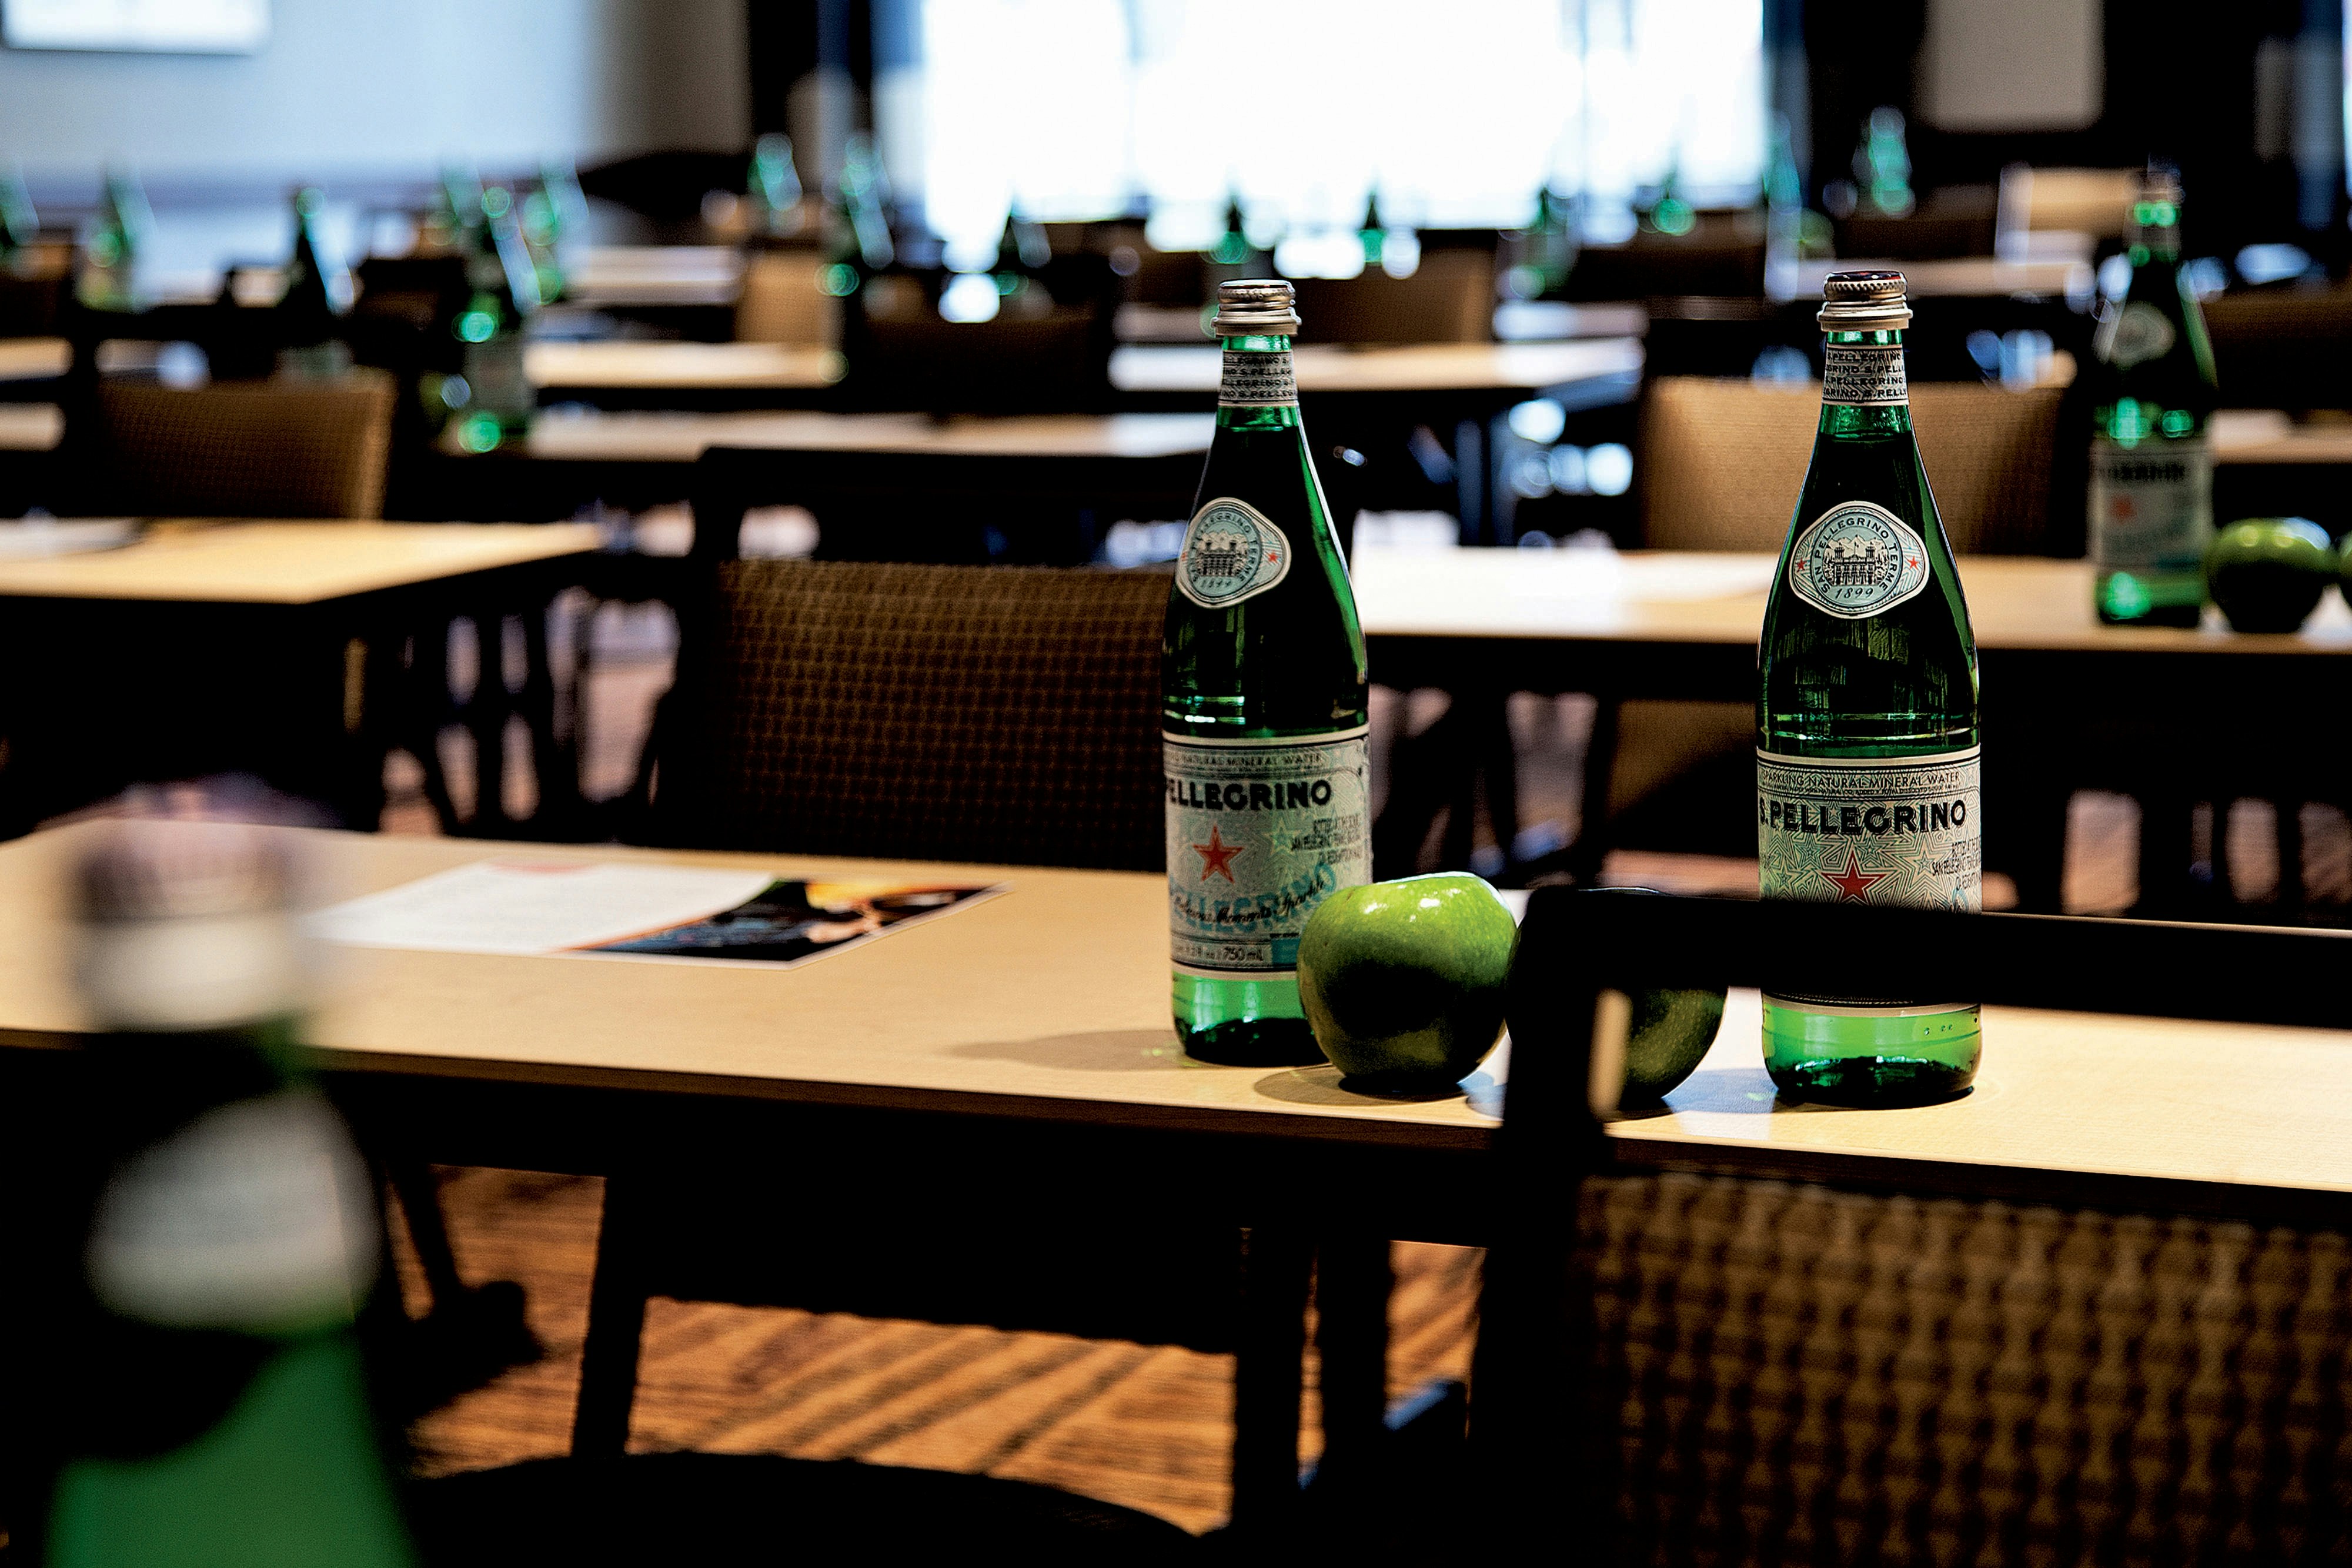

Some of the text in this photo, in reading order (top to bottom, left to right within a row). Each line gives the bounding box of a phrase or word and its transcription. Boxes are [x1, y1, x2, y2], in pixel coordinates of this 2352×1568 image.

[1815, 517, 1898, 594] SAN PELLEGRINO TERME
[1835, 587, 1874, 599] 1899
[1808, 775, 1864, 788] NATURAL
[1869, 775, 1924, 788] MINERAL
[1927, 771, 1960, 785] WATER
